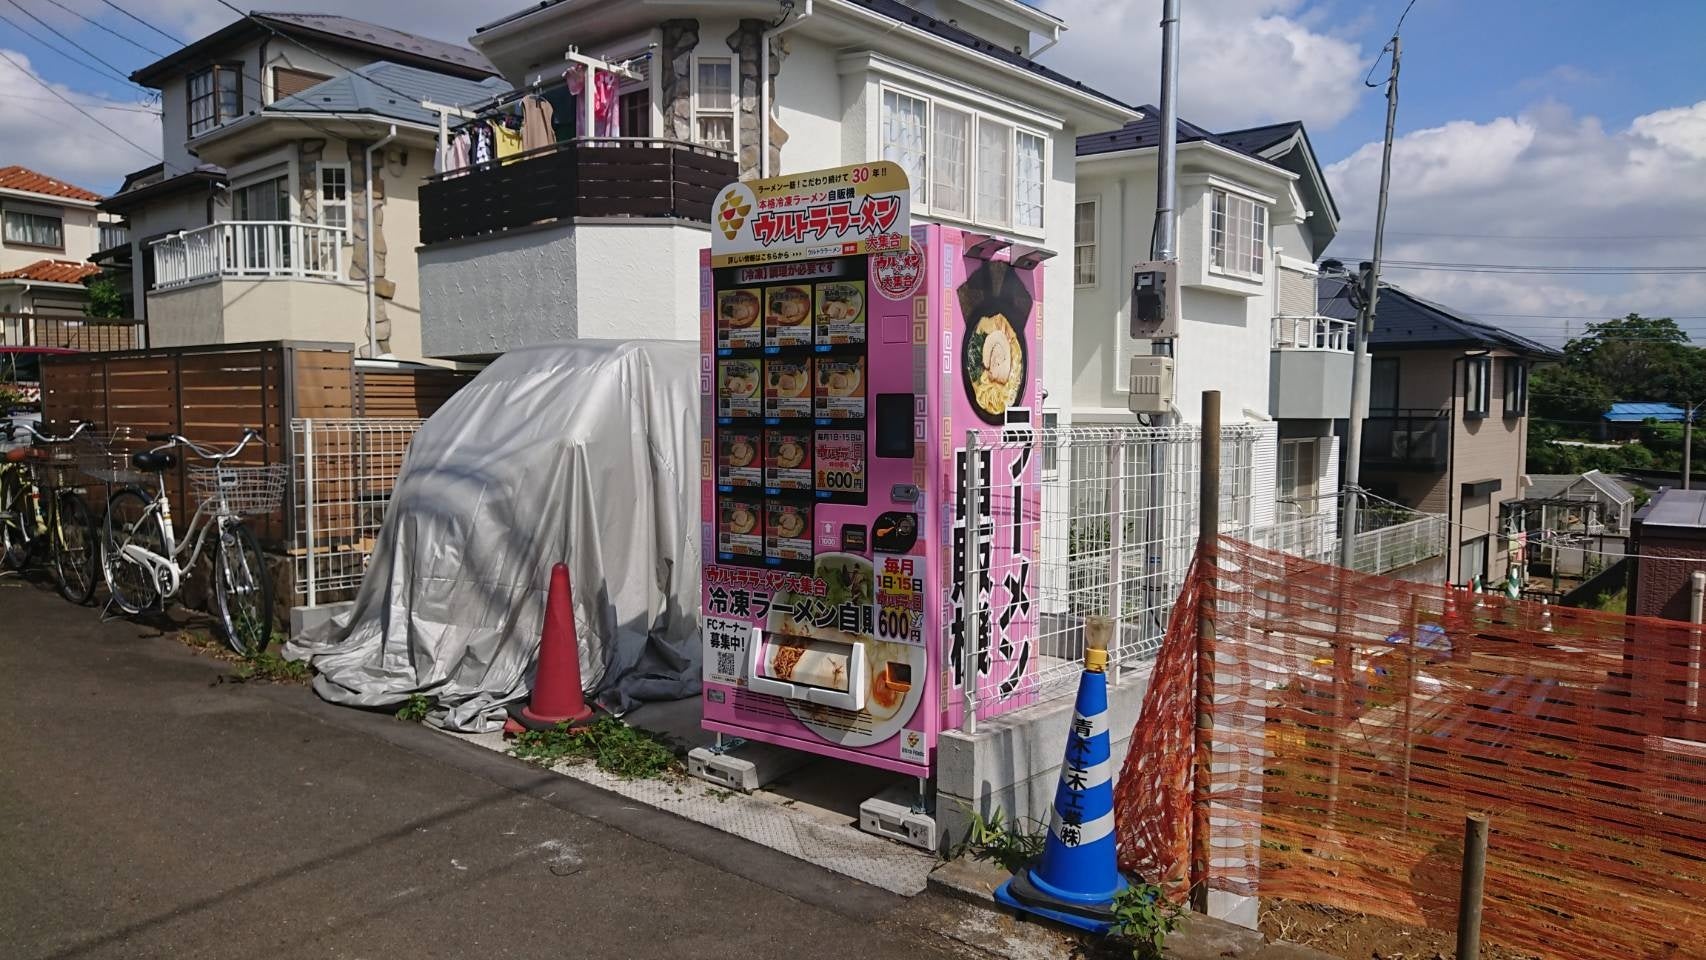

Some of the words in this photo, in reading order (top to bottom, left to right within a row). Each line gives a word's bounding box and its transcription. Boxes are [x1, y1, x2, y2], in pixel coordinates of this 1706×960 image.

[758, 187, 856, 210] 本格冷凍ラーメン自販機
[751, 194, 901, 247] ウルトララーメン
[865, 232, 903, 250] 大集合
[881, 274, 914, 289] 大集合
[999, 407, 1034, 700] ラーメン
[884, 557, 914, 576] 毎月
[704, 566, 829, 598] ウルトララーメン大集合
[706, 618, 748, 632] FCオーナー
[710, 632, 746, 652] 募集中!
